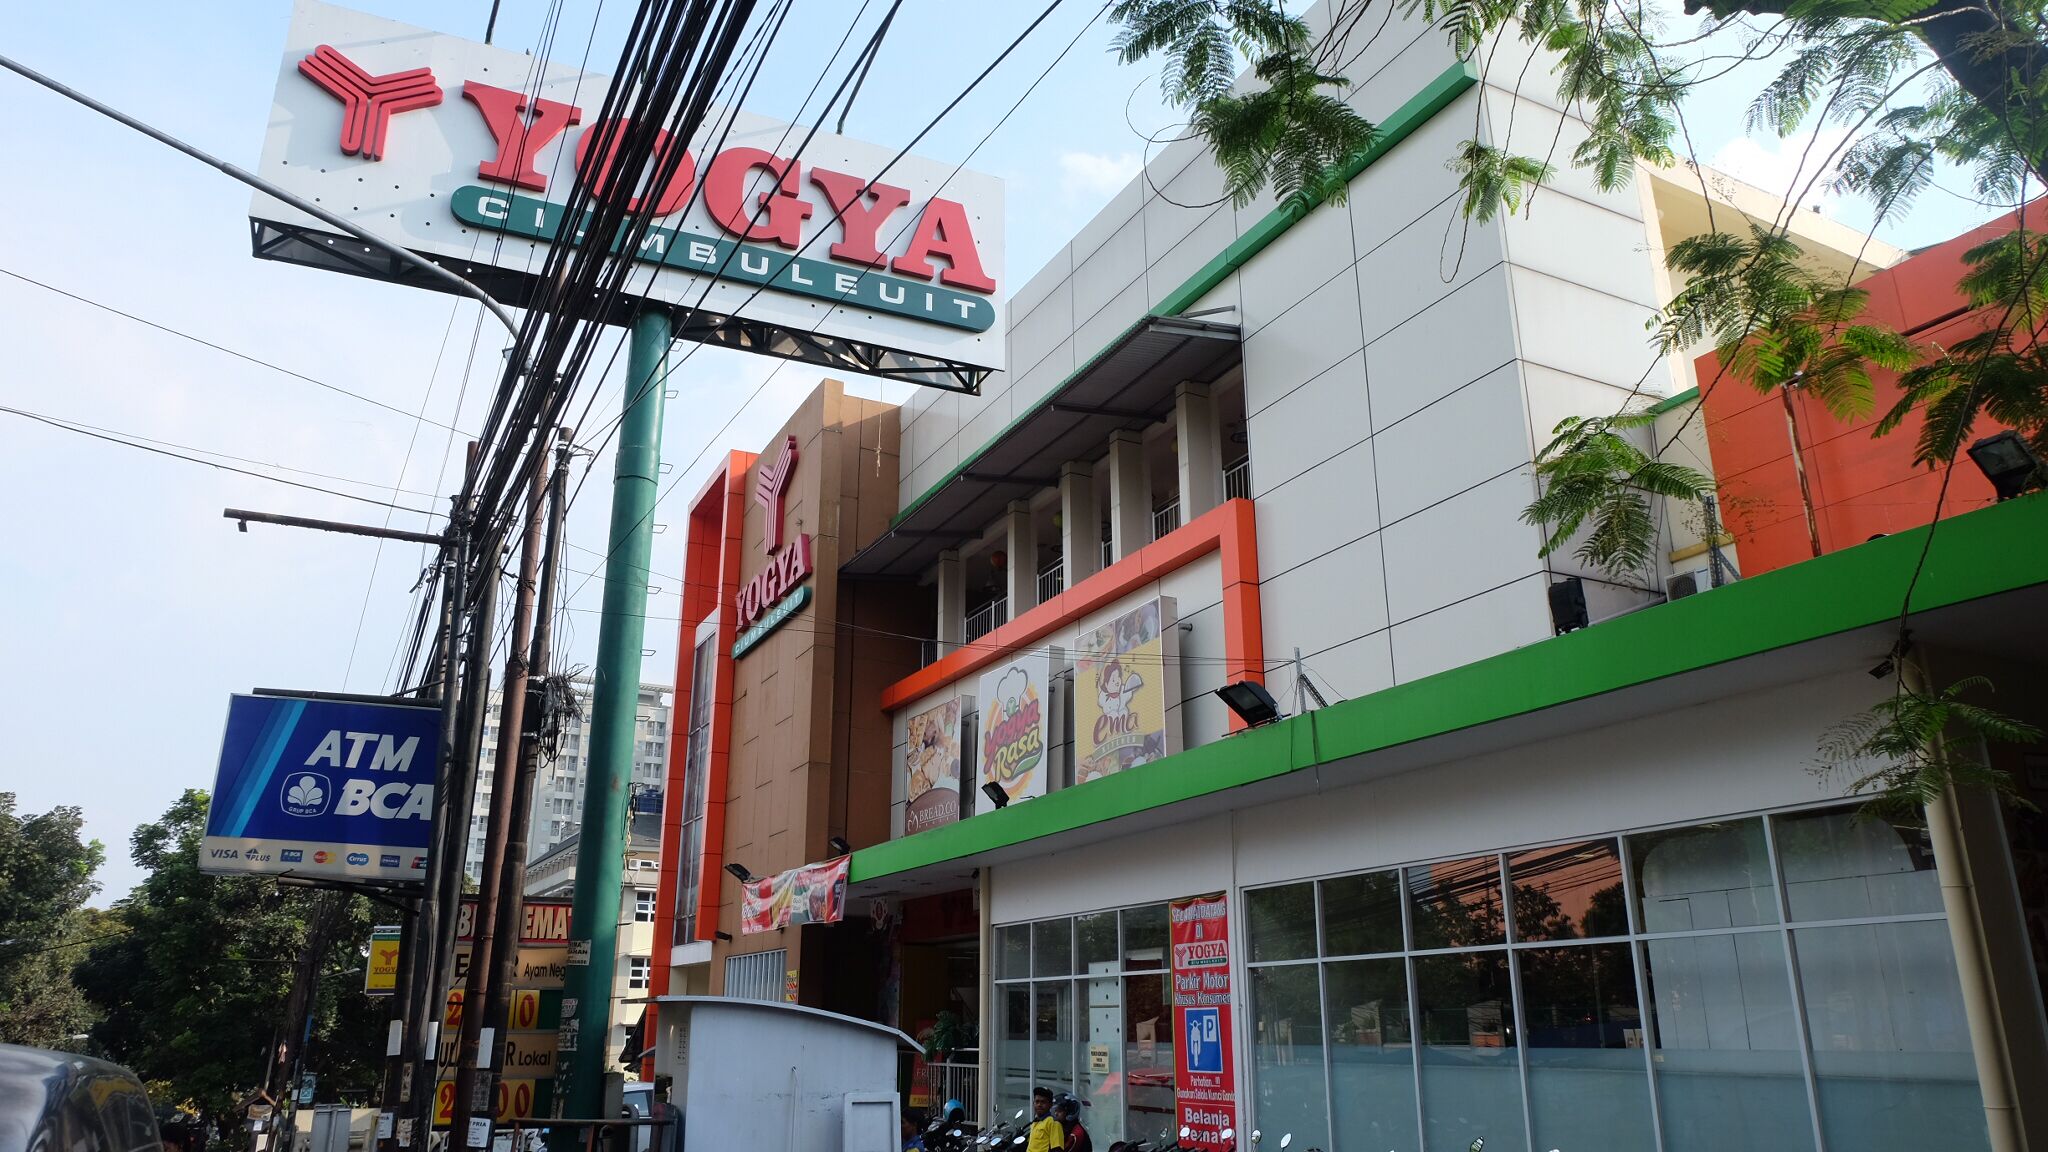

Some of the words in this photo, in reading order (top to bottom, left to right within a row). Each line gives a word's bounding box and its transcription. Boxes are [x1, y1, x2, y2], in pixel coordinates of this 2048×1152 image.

[462, 80, 996, 294] YOGYA
[477, 196, 976, 319] CIMBULEUIT
[736, 533, 811, 632] YOGYA
[1093, 712, 1139, 746] ema
[304, 730, 421, 772] ATM
[334, 778, 435, 821] BCA
[919, 799, 957, 822] BREAD.CO
[210, 849, 239, 860] VISA
[250, 853, 272, 862] PLUS
[1187, 943, 1226, 959] YOGYA
[524, 963, 548, 980] Ayam
[549, 963, 567, 981] Neg
[518, 1051, 551, 1066] Lokal
[1185, 1107, 1230, 1130] Belanja
